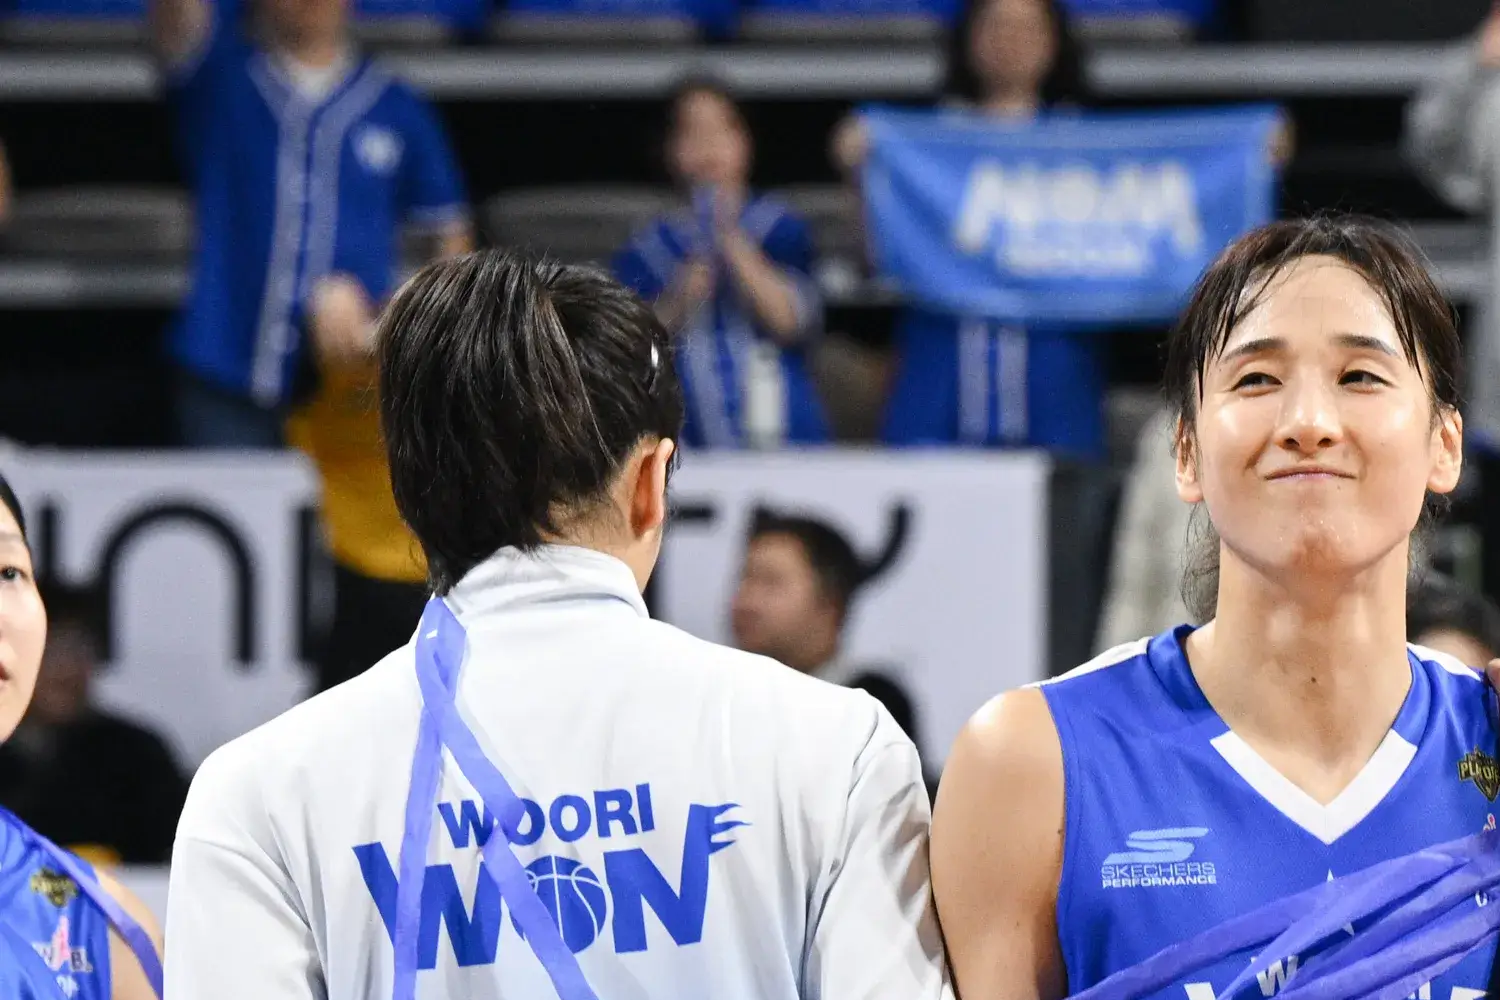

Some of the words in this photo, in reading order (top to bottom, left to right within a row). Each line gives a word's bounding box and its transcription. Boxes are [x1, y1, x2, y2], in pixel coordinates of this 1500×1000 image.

[437, 782, 656, 849] WOORI
[352, 803, 752, 970] WON
[1101, 861, 1216, 879] SKECHERS
[1102, 875, 1217, 889] PERFORMANCE
